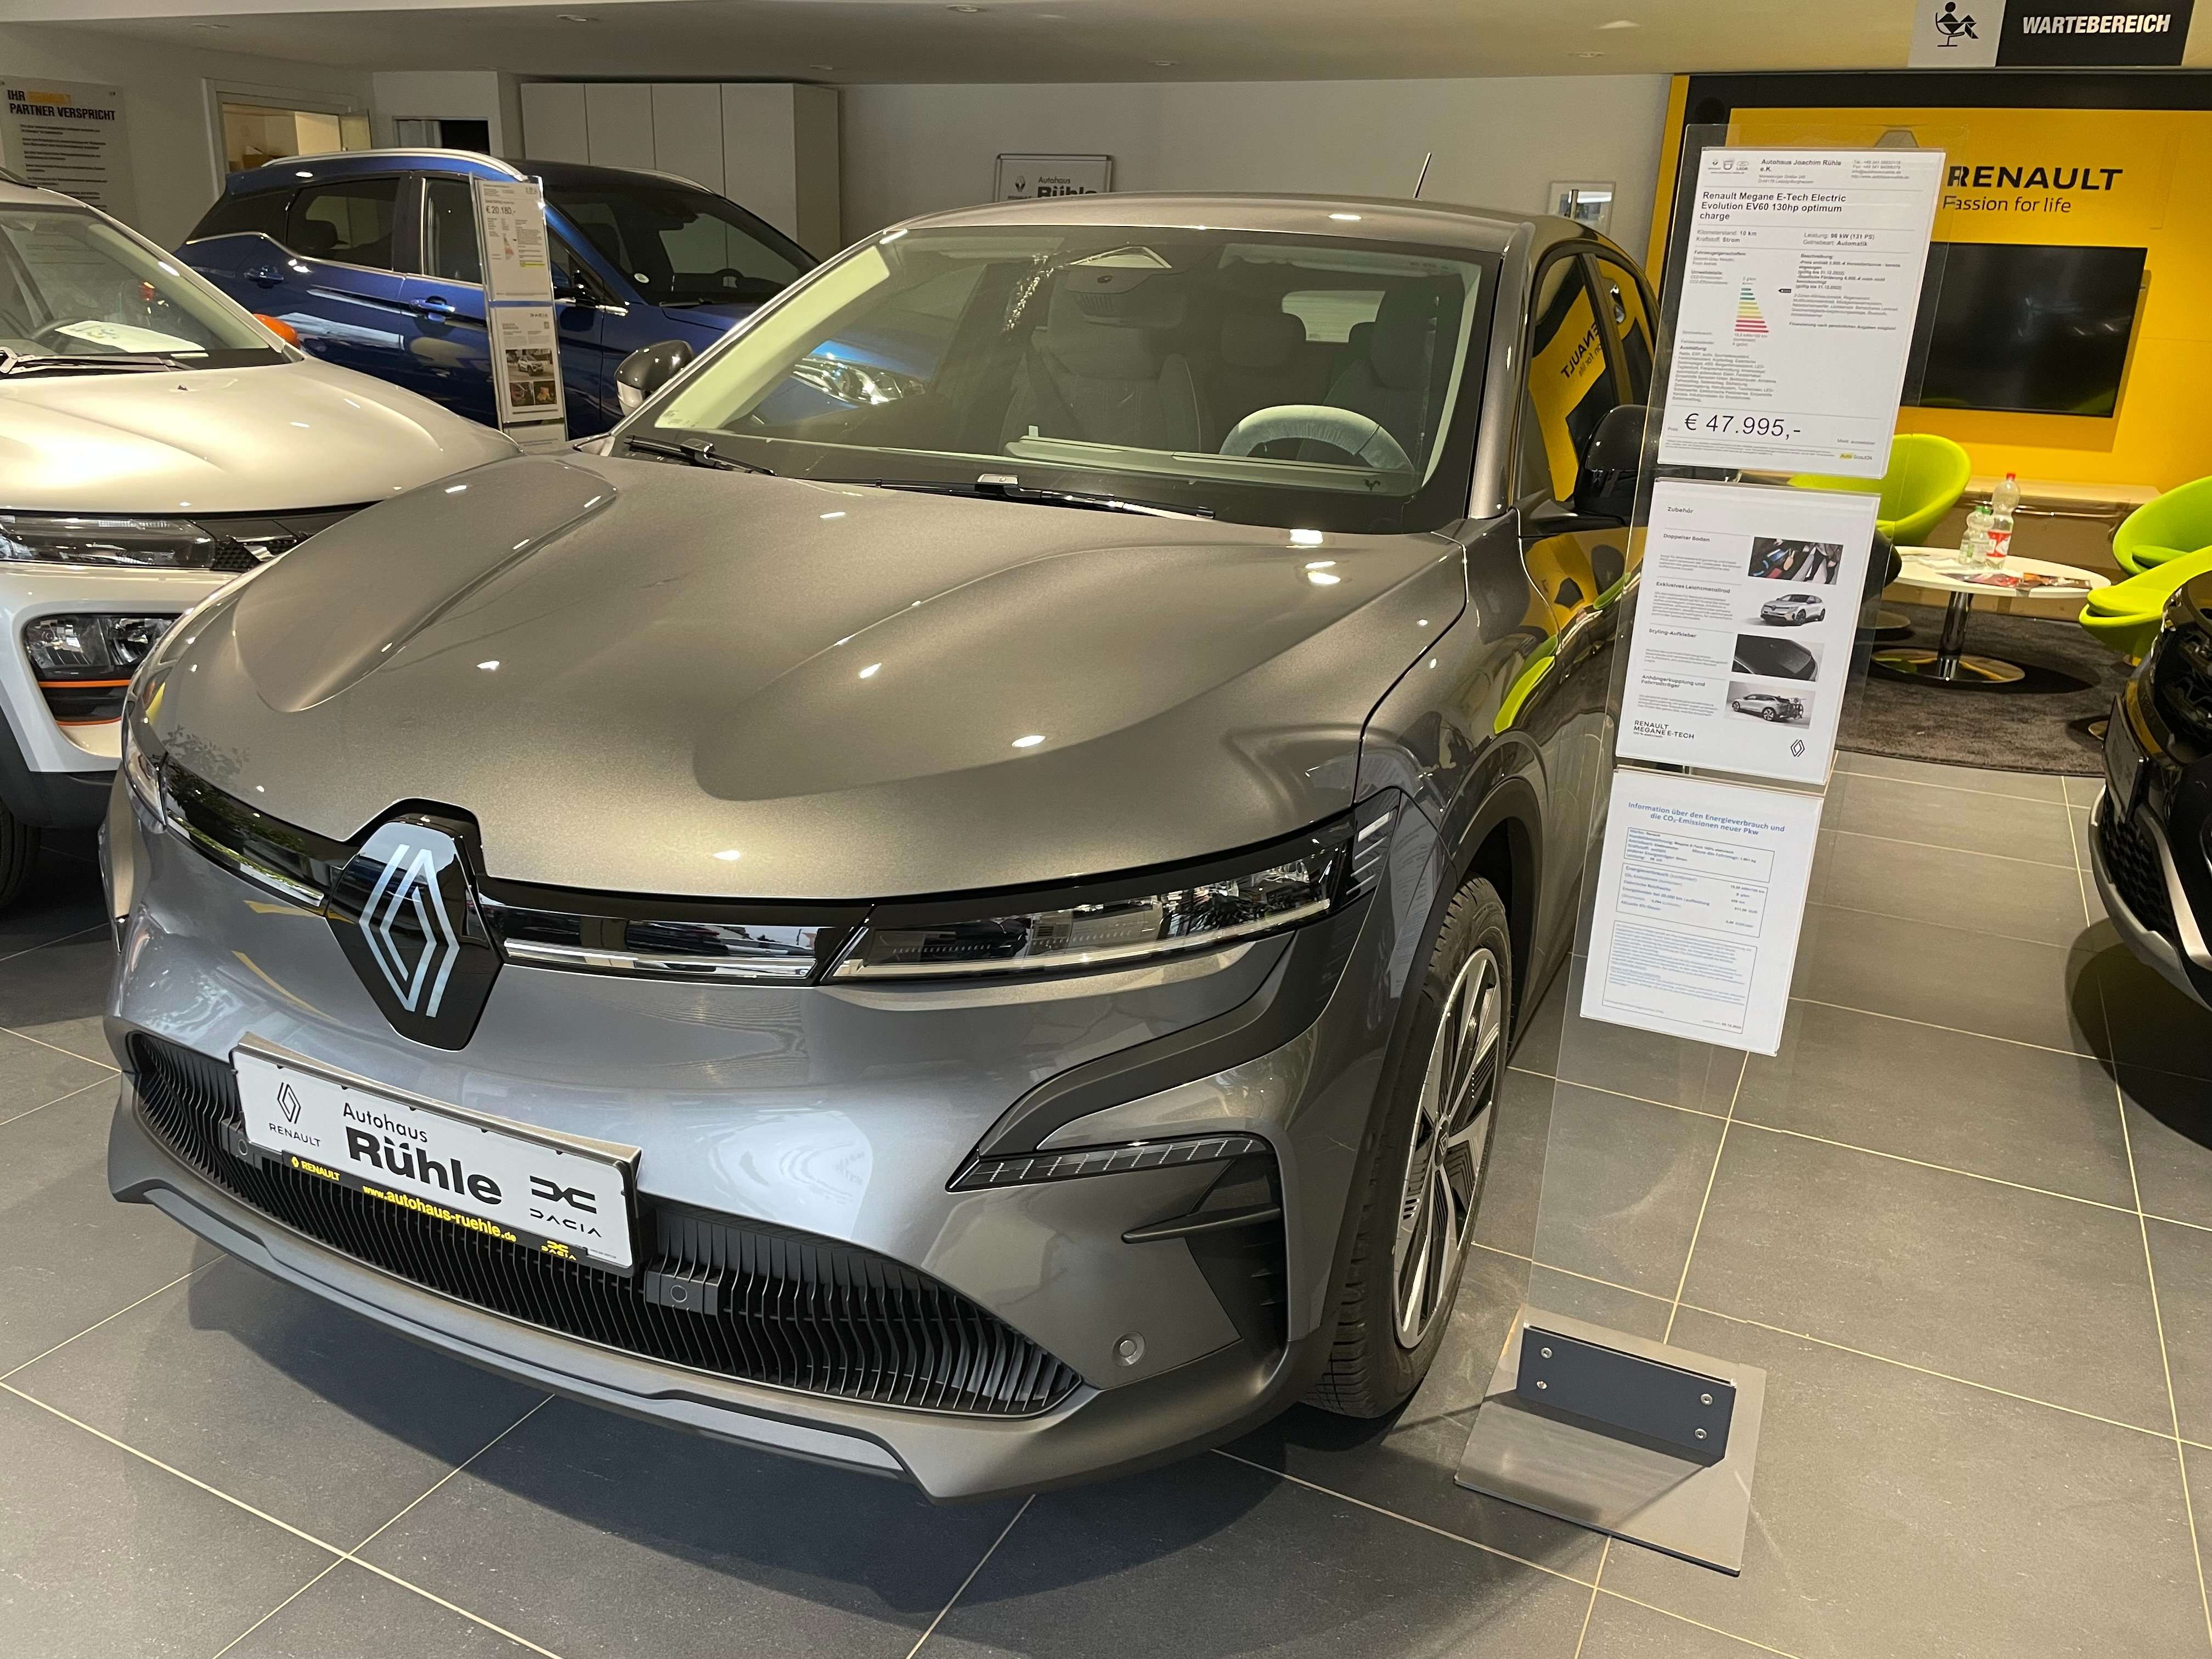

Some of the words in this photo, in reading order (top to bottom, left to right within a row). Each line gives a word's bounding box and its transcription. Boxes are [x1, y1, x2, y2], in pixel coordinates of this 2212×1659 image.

[2022, 14, 2171, 34] WARTEBEREICH
[7, 89, 26, 101] IHR
[9, 103, 55, 117] PARTNER
[57, 107, 116, 121] VERSPRICHT
[1946, 166, 2124, 191] RENAULT
[1739, 193, 1774, 202] Megane
[1777, 193, 1808, 201] E-Tech
[1811, 194, 1847, 202] Electric
[2015, 196, 2039, 212] for
[2044, 198, 2072, 213] life
[1701, 202, 1743, 210] Evolution
[1772, 204, 1799, 213] 130hp
[1801, 205, 1842, 213] optimum
[1700, 212, 1730, 221] charge
[1684, 413, 1699, 431] €
[1706, 414, 1801, 441] 47.995,-
[1685, 585, 1730, 594] Leichtmetallrad
[1649, 628, 1697, 638] Styling-Aufkleber
[1641, 679, 1680, 688] Fahrradträger
[1642, 674, 1694, 686] Anhängerkupplung
[1633, 726, 1666, 736] MEGANE
[1667, 730, 1695, 740] E-TECH
[1634, 720, 1669, 730] RENAULT
[1628, 802, 1671, 814] Information
[1672, 808, 1689, 816] über
[1705, 814, 1769, 830] Energieverbrauch
[1770, 823, 1785, 832] und
[1720, 825, 1742, 833] neuer
[342, 1102, 428, 1143] Autohaus
[268, 1122, 321, 1147] RENAULT
[301, 1160, 340, 1181] RENAULT
[345, 1126, 503, 1206] Rühle
[362, 1184, 517, 1243] www.autohaus-ruehle.de
[529, 1208, 602, 1238] DACIA
[540, 1245, 577, 1261] DACIA
